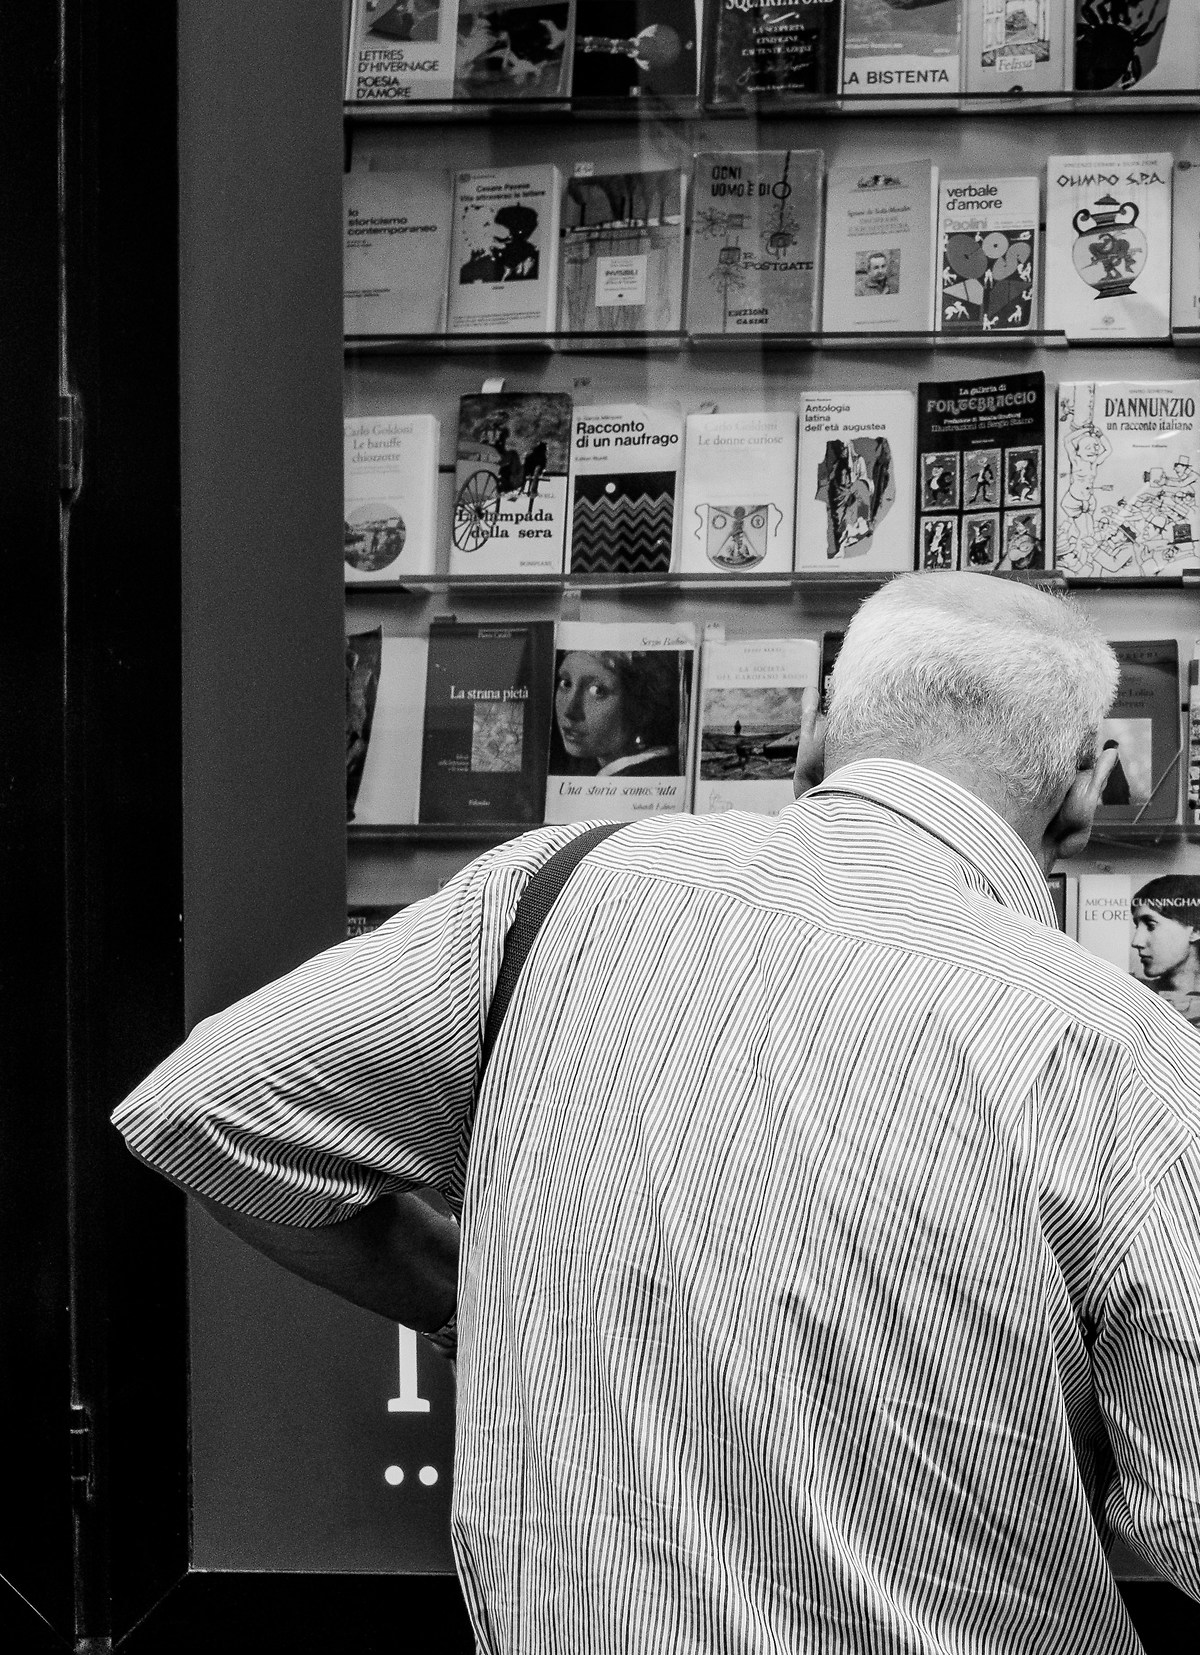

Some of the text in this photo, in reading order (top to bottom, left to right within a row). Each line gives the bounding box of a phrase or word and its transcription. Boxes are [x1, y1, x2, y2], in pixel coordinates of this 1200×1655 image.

[359, 50, 403, 61] LETTRES
[358, 60, 439, 73] D'HIVERNAGE
[357, 76, 400, 87] POESIA
[867, 69, 949, 84] BISTENTA
[357, 87, 411, 99] D'AMORE
[711, 165, 742, 180] OGNI
[1056, 174, 1120, 187] OLIMPO
[711, 182, 745, 197] UOMO
[946, 184, 998, 197] verbale
[946, 198, 1003, 211] d'amore
[347, 225, 438, 236] contemporaneo
[943, 217, 988, 231] Paolini
[743, 260, 814, 272] POSTGATE
[805, 404, 850, 413] Antologia
[926, 390, 1036, 415] FORTEBRACCIO
[1104, 397, 1196, 417] D'ANNUNZIO
[805, 414, 831, 422] latina
[1106, 418, 1193, 431] un racconto italiano
[576, 420, 645, 435] Racconto
[805, 423, 886, 432] dell'età augustea
[353, 439, 365, 450] Le
[576, 432, 679, 449] di un naufrago
[698, 433, 783, 446] Le donne curiose
[484, 509, 554, 525] lampada
[471, 527, 553, 539] della sera
[450, 685, 529, 702] La strana pietà
[559, 781, 582, 796] Una
[585, 782, 617, 796] storia
[1085, 898, 1129, 907] MICHAEL
[1084, 909, 1130, 921] LE ORE
